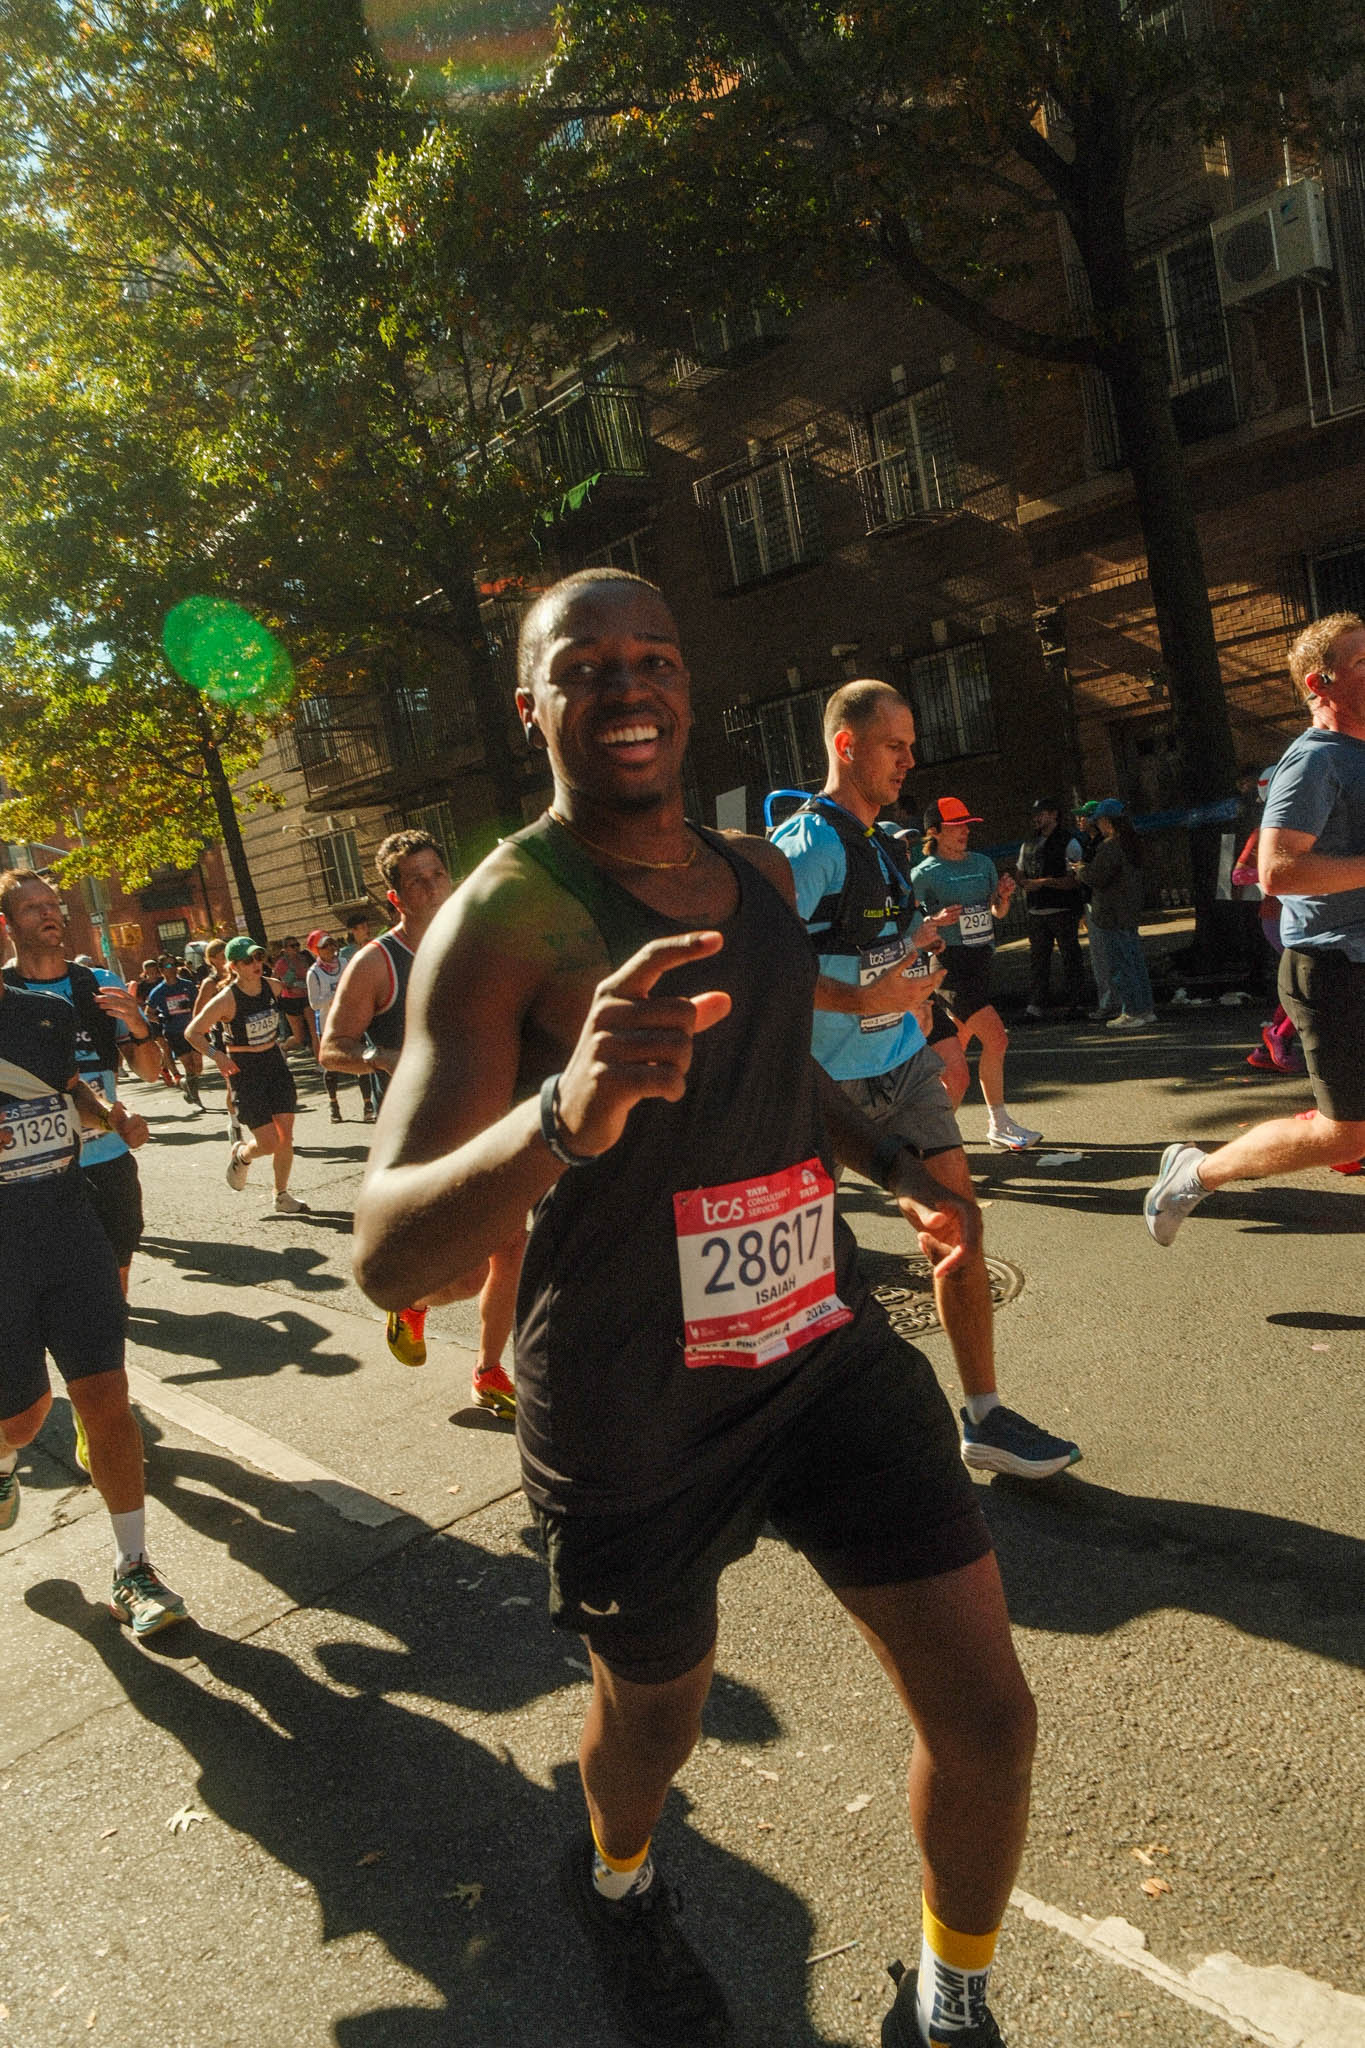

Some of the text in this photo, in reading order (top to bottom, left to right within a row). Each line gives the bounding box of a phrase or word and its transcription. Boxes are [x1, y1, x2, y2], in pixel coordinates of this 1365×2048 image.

[869, 952, 884, 966] tcs
[746, 1185, 769, 1198] TATA
[702, 1197, 744, 1225] tcs
[702, 1204, 823, 1295] 28617
[755, 1277, 796, 1305] ISAIAH
[931, 1959, 965, 2025] TEAM
